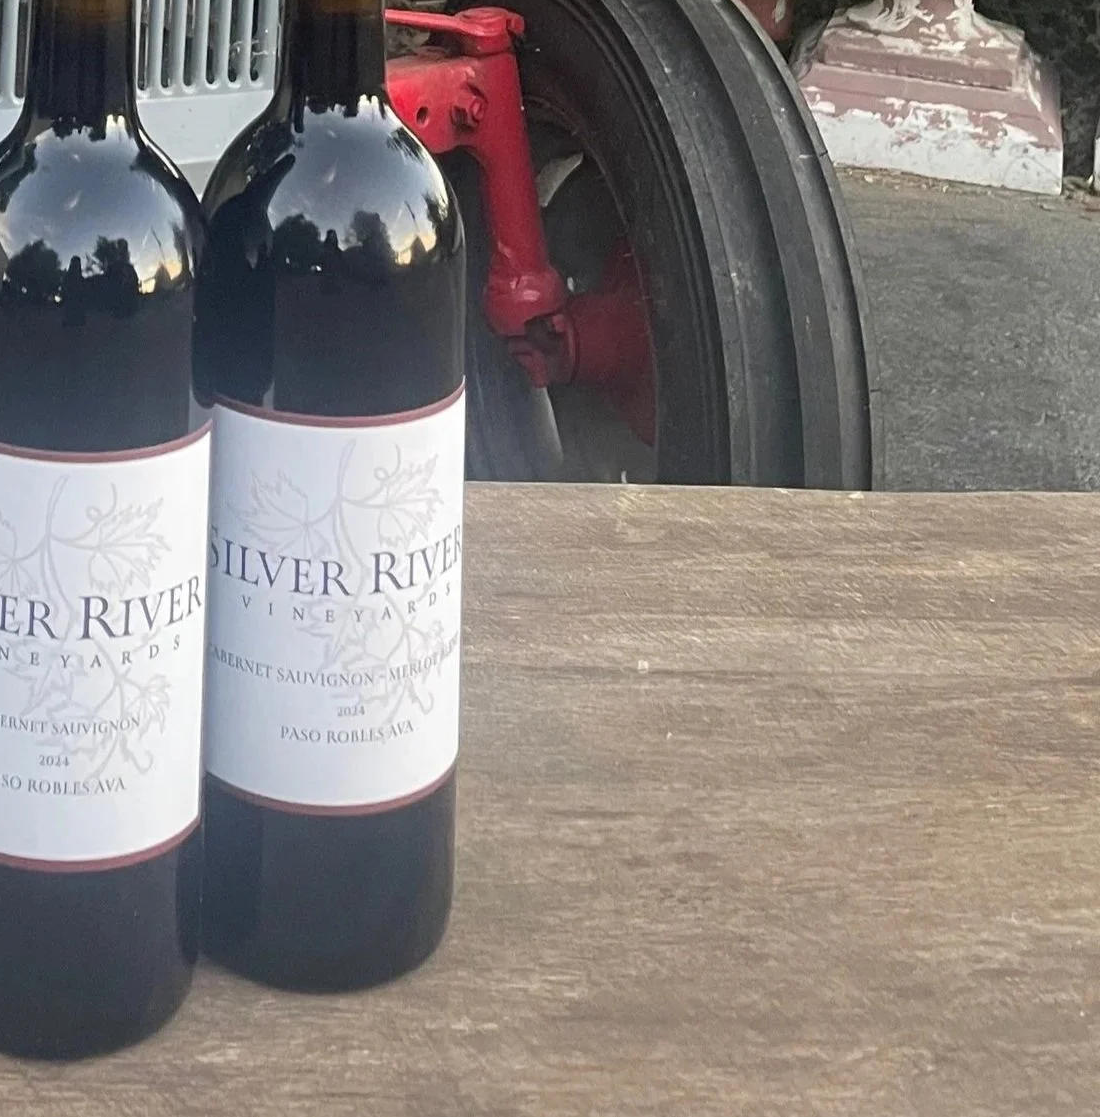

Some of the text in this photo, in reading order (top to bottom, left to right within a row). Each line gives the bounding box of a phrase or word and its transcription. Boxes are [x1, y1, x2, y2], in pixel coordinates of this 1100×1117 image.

[210, 524, 461, 597] SILVER RIVER
[76, 575, 202, 640] RIVER
[241, 580, 451, 623] VINEYARDS
[276, 668, 374, 688] SAUVIGNON
[388, 652, 438, 682] MERLOT
[337, 706, 365, 717] 2024
[51, 715, 141, 736] SAUVIGNON
[280, 720, 414, 745] PASO ROBLES AVA
[38, 754, 70, 767] 2024
[27, 778, 90, 795] ROBLES
[94, 777, 126, 795] AVA
